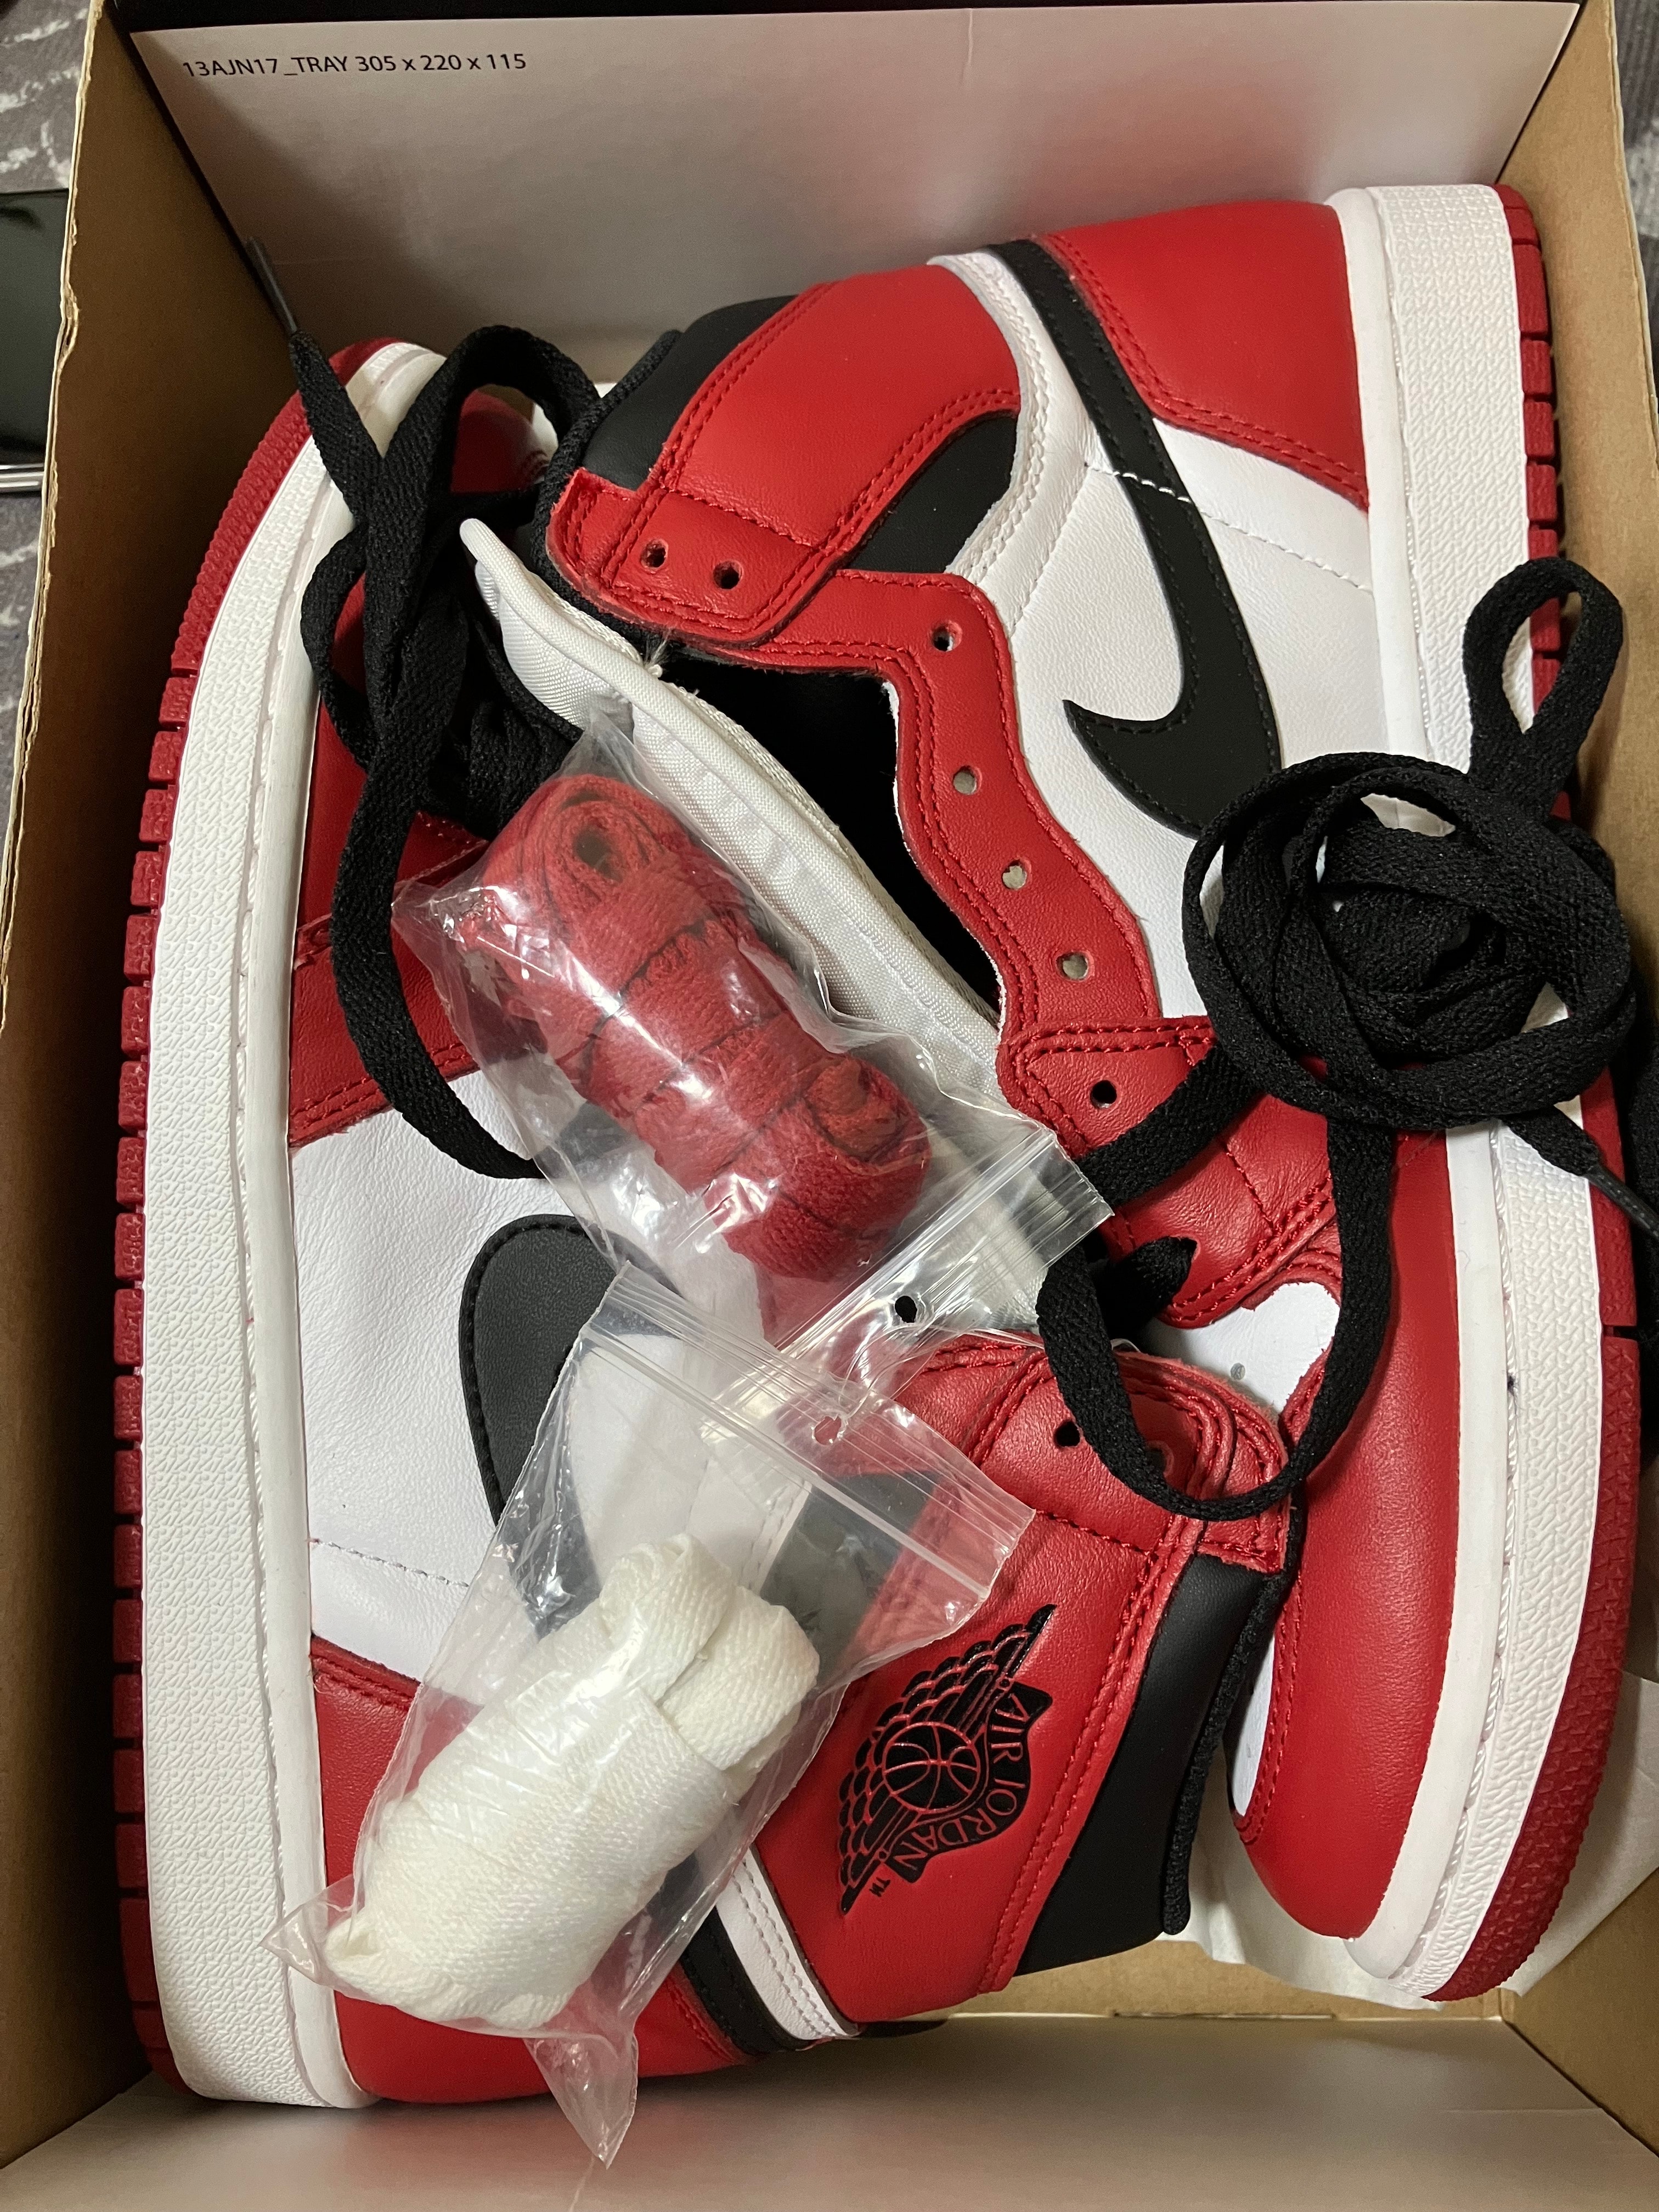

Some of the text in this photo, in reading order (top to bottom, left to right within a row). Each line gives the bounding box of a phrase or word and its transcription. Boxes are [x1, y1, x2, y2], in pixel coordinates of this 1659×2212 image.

[354, 55, 397, 72] 305
[402, 59, 417, 71] x
[420, 54, 462, 71] 220
[466, 57, 482, 70] x
[486, 53, 526, 70] 115
[893, 1692, 1030, 1871] AIR JORDAN
